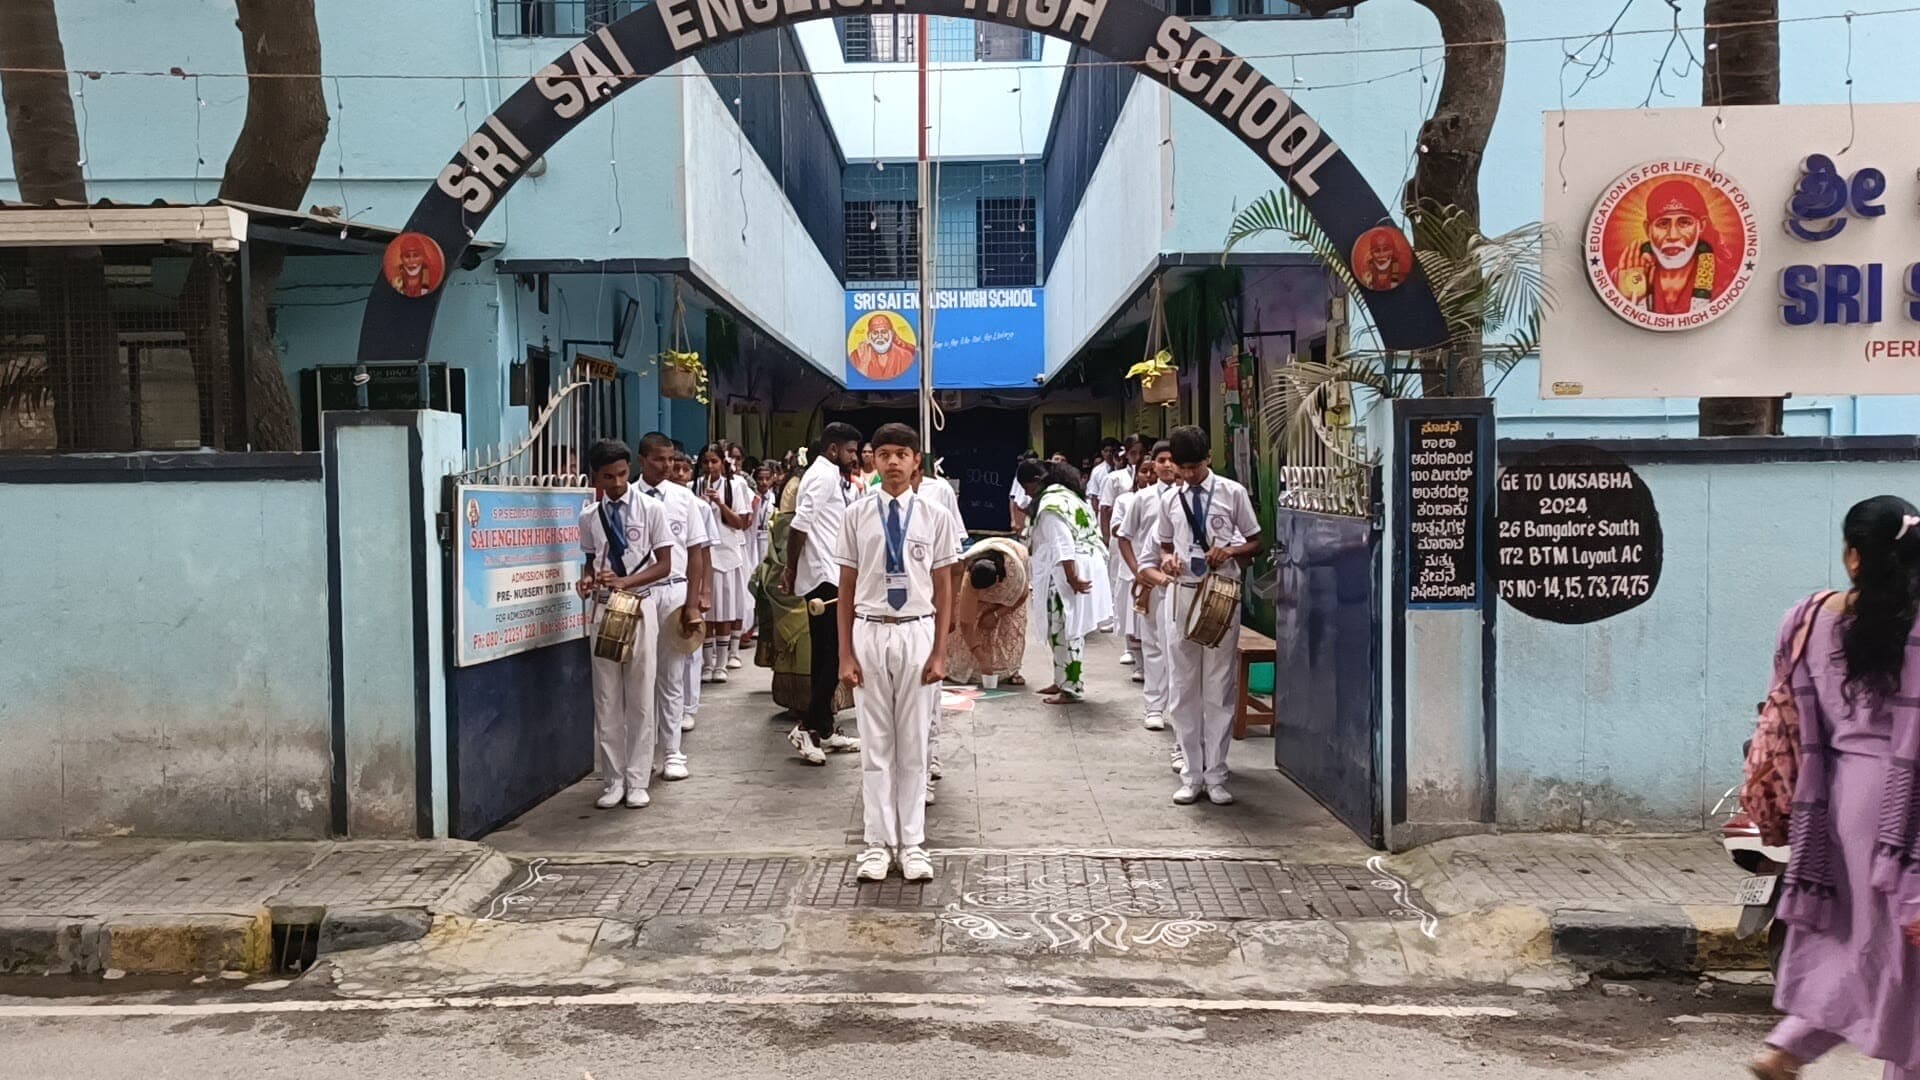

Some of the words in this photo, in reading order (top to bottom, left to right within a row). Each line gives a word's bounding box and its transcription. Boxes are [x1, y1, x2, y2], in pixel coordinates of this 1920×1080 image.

[437, 113, 533, 213] SRI
[534, 27, 636, 119] SAI
[1145, 15, 1340, 197] SCHOOL
[1787, 153, 1886, 242] ಶ್ರೀ
[1590, 182, 1627, 253] EDUCATION
[1626, 173, 1640, 186] IS
[1642, 162, 1670, 177] FOR
[1673, 161, 1702, 175] LIFE
[1704, 167, 1732, 188] NOT
[1728, 186, 1750, 213] FOR
[1744, 213, 1758, 257] LIVING
[853, 293, 875, 310] SRI
[877, 292, 900, 310] SAI
[903, 291, 958, 309] ENLISH
[960, 290, 987, 308] HIGH
[988, 289, 1037, 308] SCHOOL
[1594, 270, 1610, 293] SRI
[1605, 289, 1623, 308] SAI
[1622, 305, 1675, 328] ENGLISH
[1678, 313, 1709, 327] HIGH
[1710, 275, 1751, 316] SCHOOL
[1781, 263, 1883, 326] SRI
[1865, 340, 1920, 362] (PER
[1411, 470, 1430, 482] 100
[1501, 473, 1520, 491] GE
[1524, 473, 1543, 491] TO
[1549, 472, 1633, 491] LOKSABHA
[1539, 497, 1588, 515] 2024
[471, 529, 489, 548] SAI
[492, 527, 533, 548] ENGLISH
[535, 527, 557, 545] HIGH
[558, 526, 580, 543] SCHO
[1499, 520, 1521, 538] 26
[1524, 520, 1596, 543] Bangalore
[1598, 519, 1640, 537] South
[1529, 546, 1569, 566] BTM
[1572, 545, 1618, 569] Layout
[1621, 544, 1643, 563] AC
[512, 570, 544, 583] ADMISSION
[514, 586, 544, 600] NURSERY
